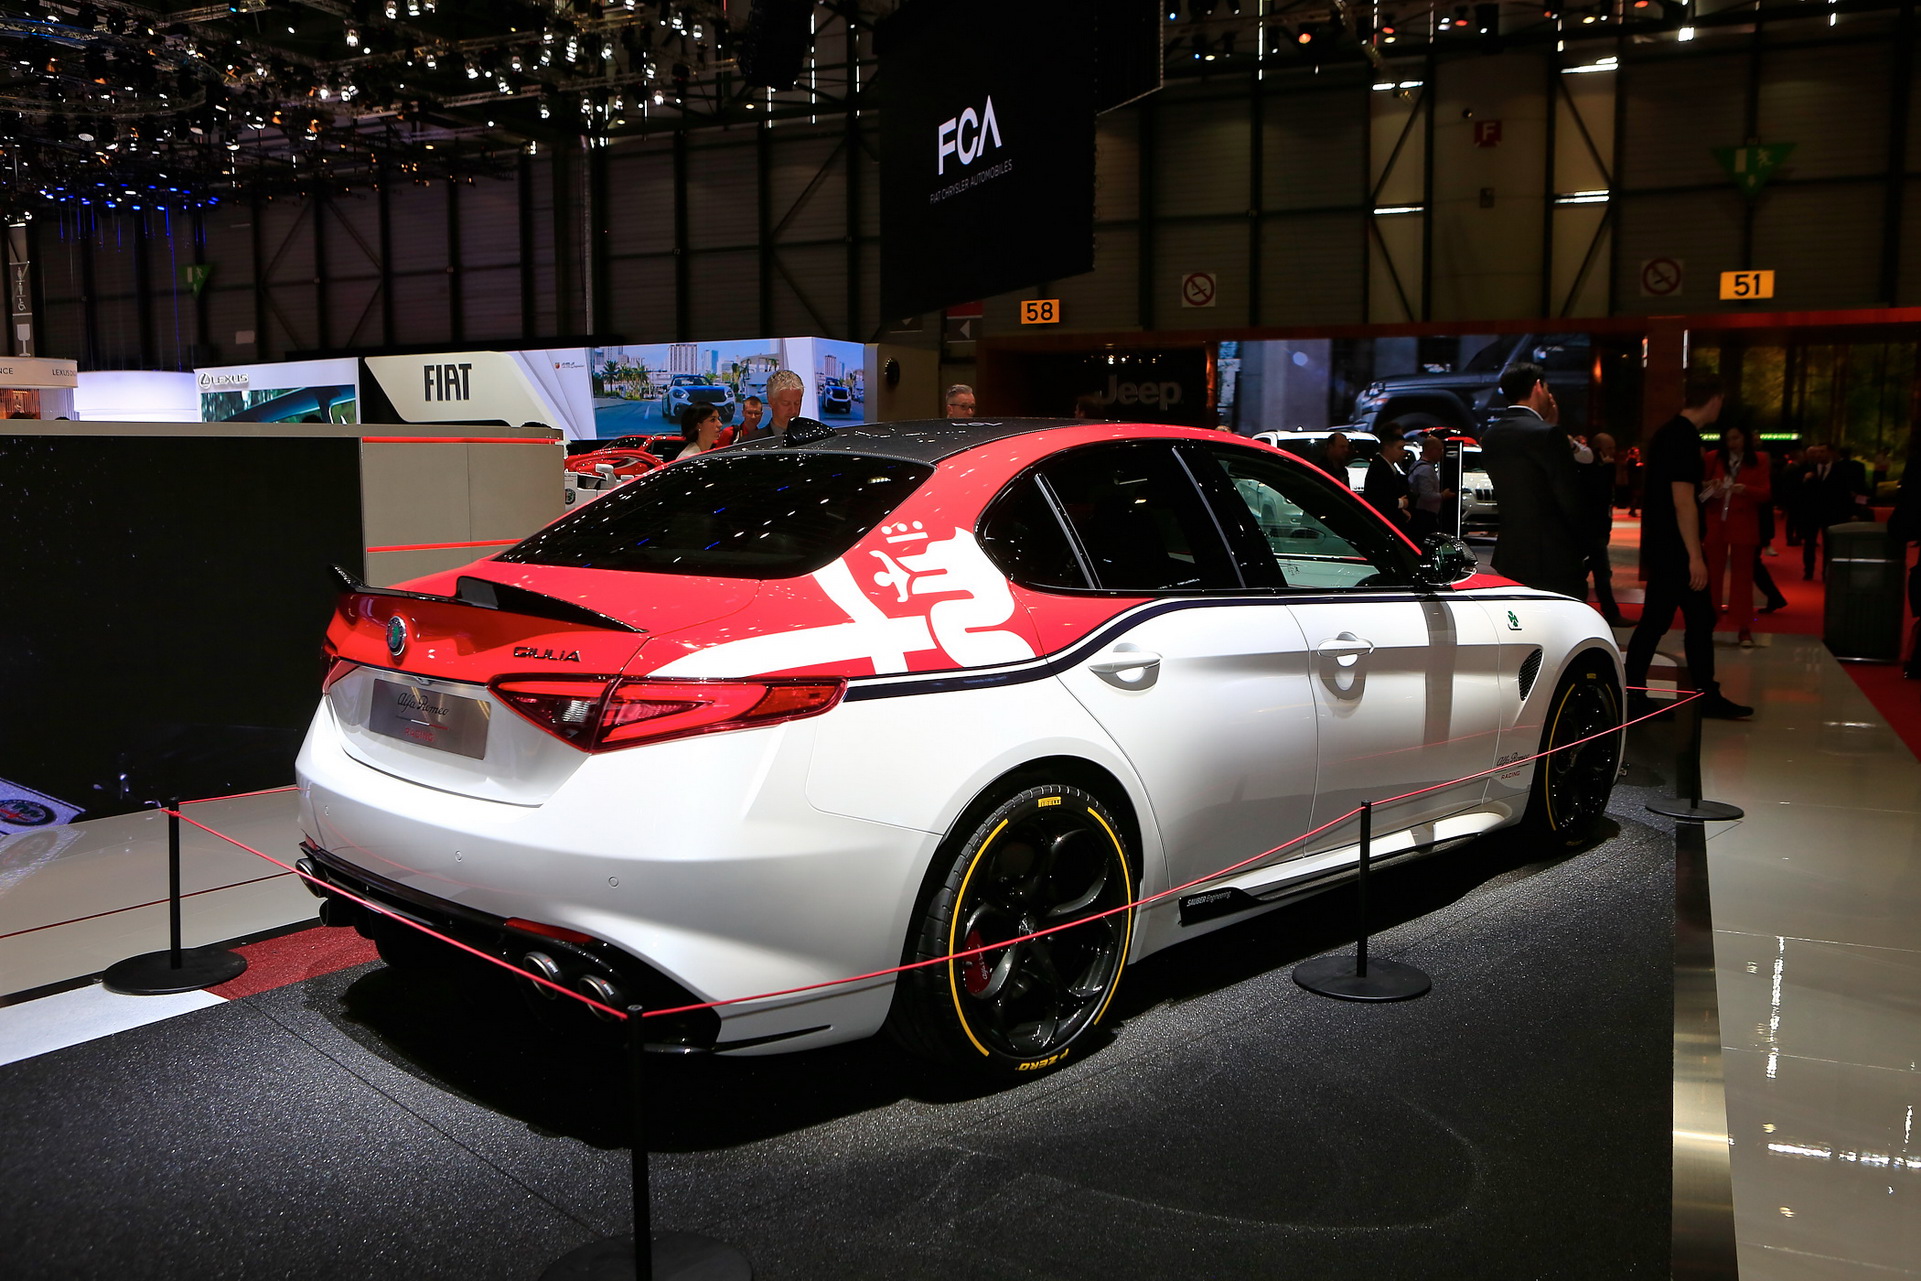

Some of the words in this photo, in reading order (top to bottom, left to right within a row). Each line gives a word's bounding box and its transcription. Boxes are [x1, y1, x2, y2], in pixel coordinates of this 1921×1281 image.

[938, 94, 1003, 176] FCA
[1482, 122, 1496, 141] F
[929, 190, 942, 205] FIAT
[941, 178, 970, 200] CHRYSLER
[969, 158, 1014, 188] AUTOMOBILES
[1733, 273, 1761, 296] 51
[1026, 301, 1054, 322] 58
[51, 368, 70, 377] LEXUS
[211, 373, 249, 385] LEXUS
[423, 363, 473, 402] FIAT
[1099, 374, 1183, 411] Jeep
[513, 646, 582, 663] GIULIA
[397, 692, 416, 713] Alfa
[416, 694, 449, 716] Romeo
[404, 727, 436, 742] RACING
[1500, 770, 1521, 780] RACING
[1186, 895, 1207, 907] SAUBER
[1018, 1054, 1059, 1072] ZERO
